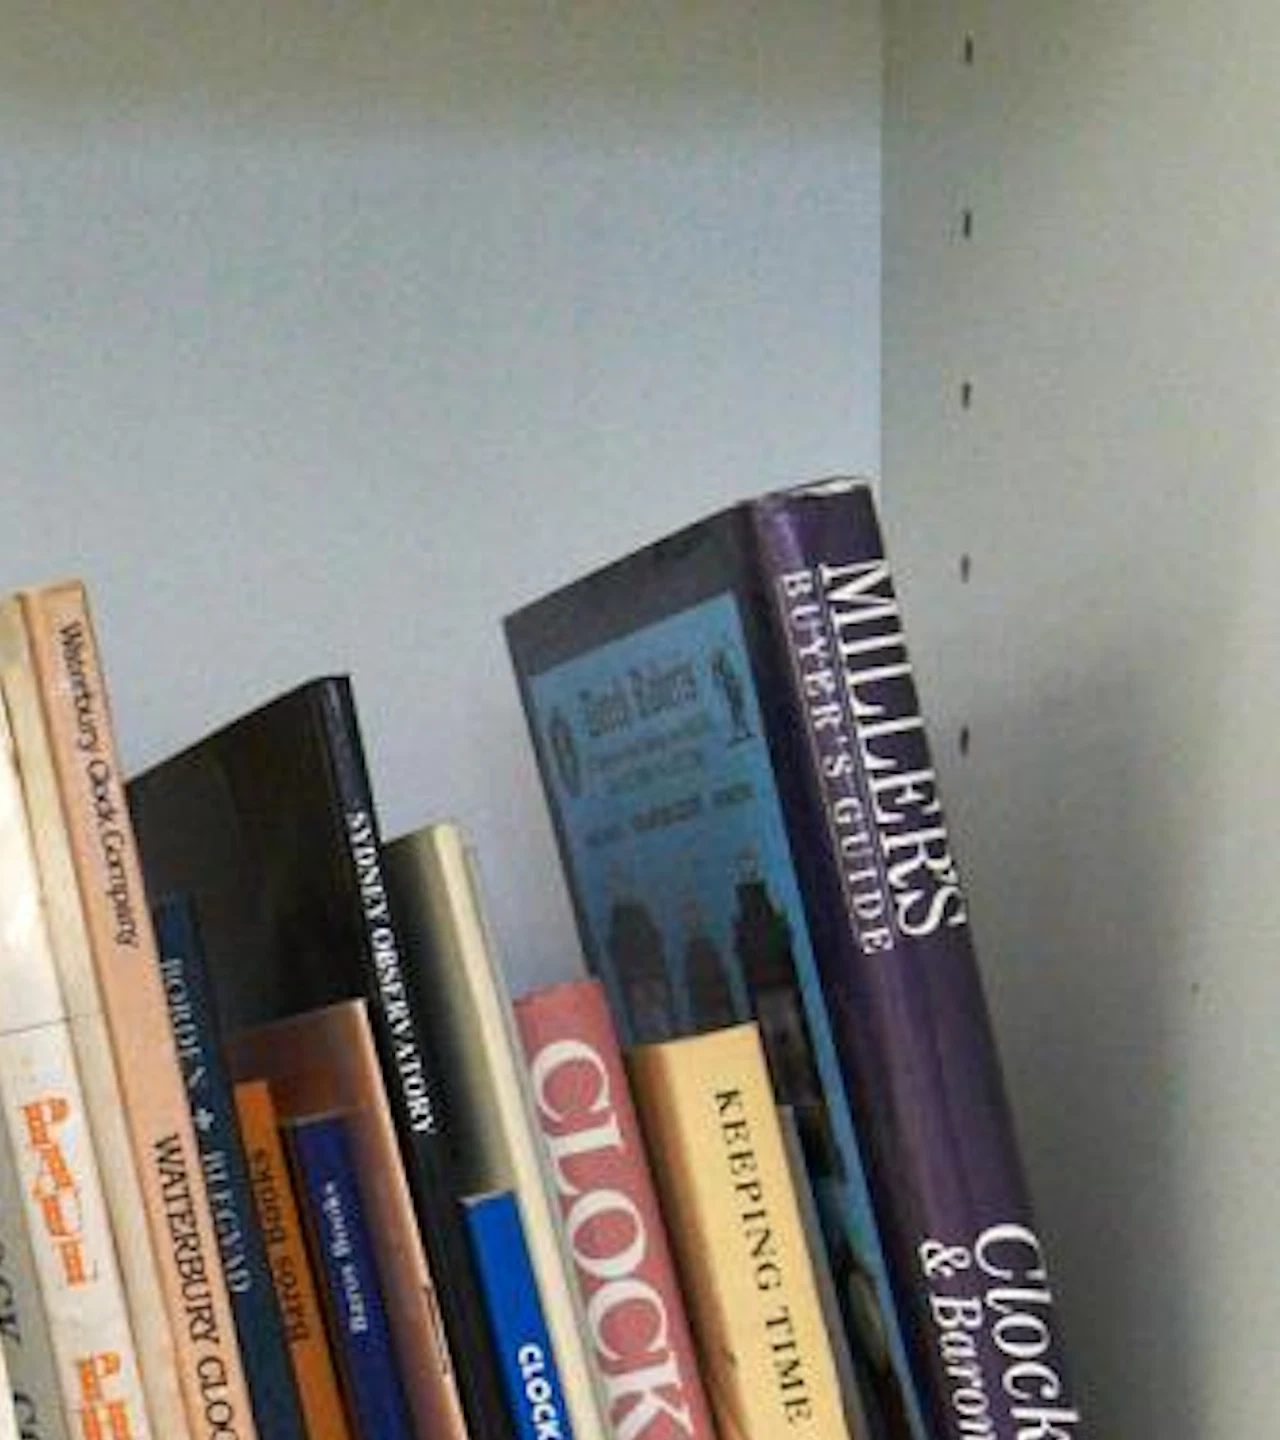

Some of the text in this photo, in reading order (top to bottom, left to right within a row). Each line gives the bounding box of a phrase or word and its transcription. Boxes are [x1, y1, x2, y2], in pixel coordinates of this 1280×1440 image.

[56, 620, 142, 950] Waterbury Clock Company
[782, 571, 894, 956] BUYER'S GUIDE
[819, 558, 967, 937] MILLER'S
[348, 810, 437, 1135] SYDNEY OBSERVATORY
[153, 1131, 219, 1349] WATERBURY
[714, 1087, 783, 1294] KEEPING
[764, 1302, 815, 1426] TIME
[919, 1239, 972, 1278] &
